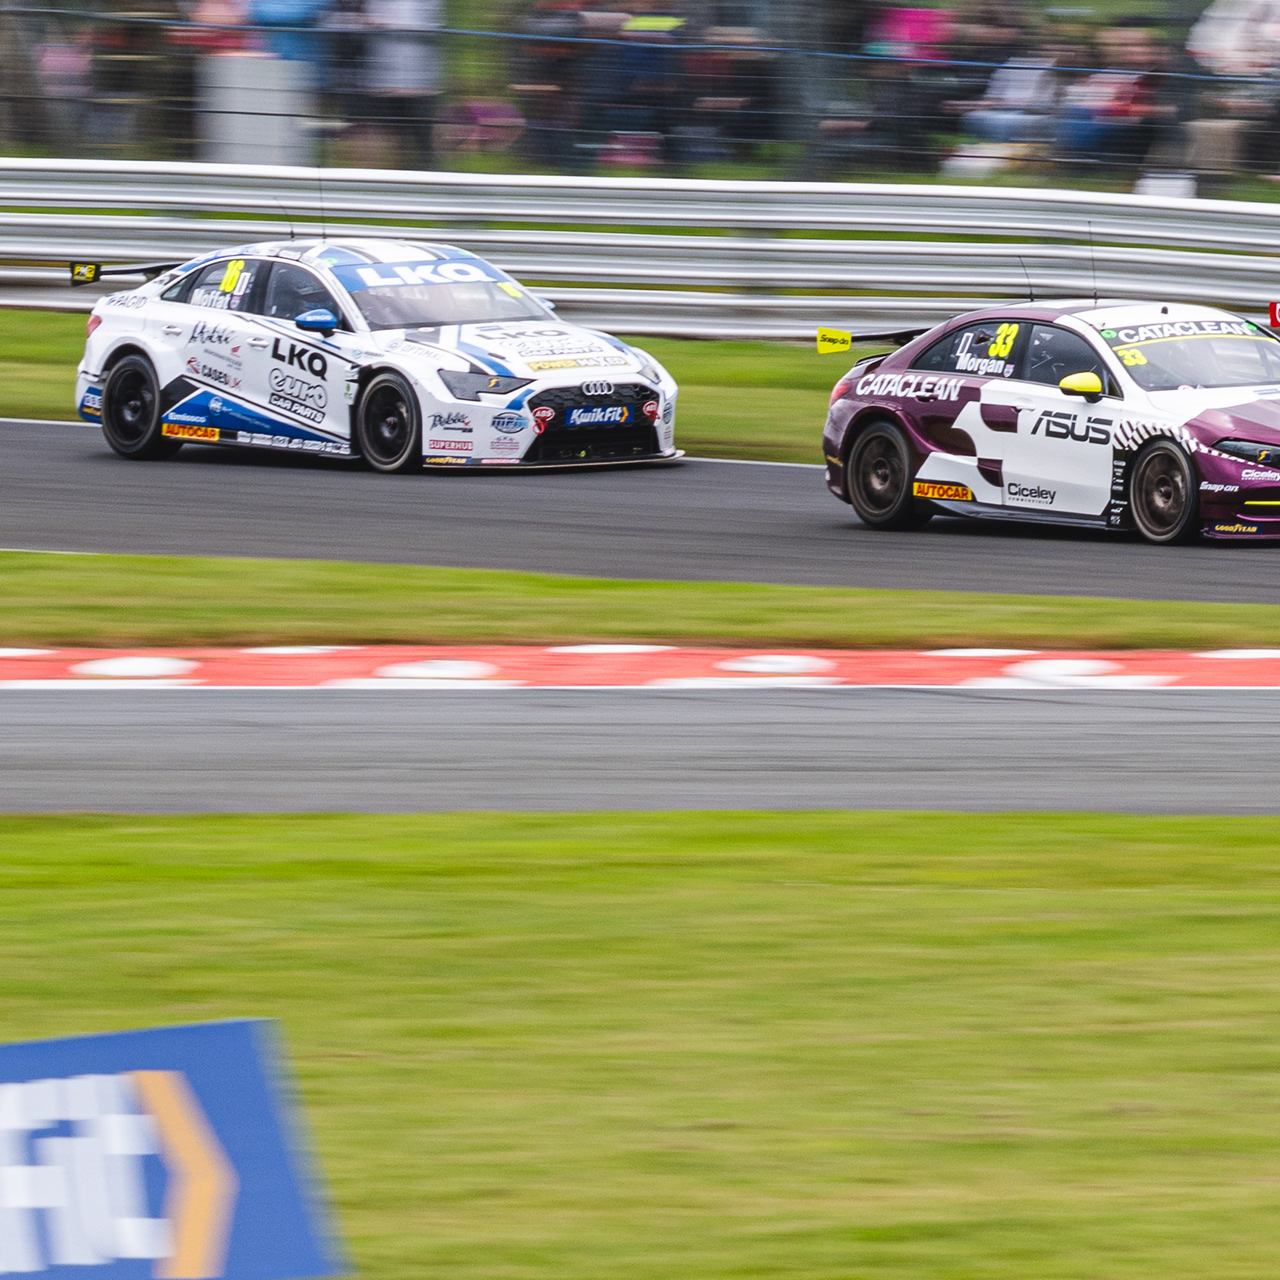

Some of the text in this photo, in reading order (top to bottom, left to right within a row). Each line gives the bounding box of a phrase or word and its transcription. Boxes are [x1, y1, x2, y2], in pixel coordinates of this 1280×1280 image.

[219, 260, 245, 292] 16
[356, 263, 499, 287] LKQ
[114, 295, 147, 308] PAGID
[190, 288, 231, 310] Moffat
[988, 323, 1019, 357] 33
[1117, 321, 1255, 343] CATACLEAN
[271, 337, 328, 382] LKQ
[955, 354, 1006, 375] Morgan
[1118, 349, 1148, 366] 33
[268, 368, 328, 409] euro
[856, 373, 966, 401] CATACLEAN
[271, 394, 291, 410] CAR
[291, 402, 324, 423] PARTS
[570, 407, 623, 424] KwikFit
[165, 424, 217, 439] AUTOCAR
[1030, 410, 1114, 445] ASUS
[916, 483, 969, 500] AUTOCAR
[1008, 482, 1056, 505] Ciceley
[1199, 481, 1239, 492] Snap-on
[1214, 524, 1258, 533] GOODYEAR
